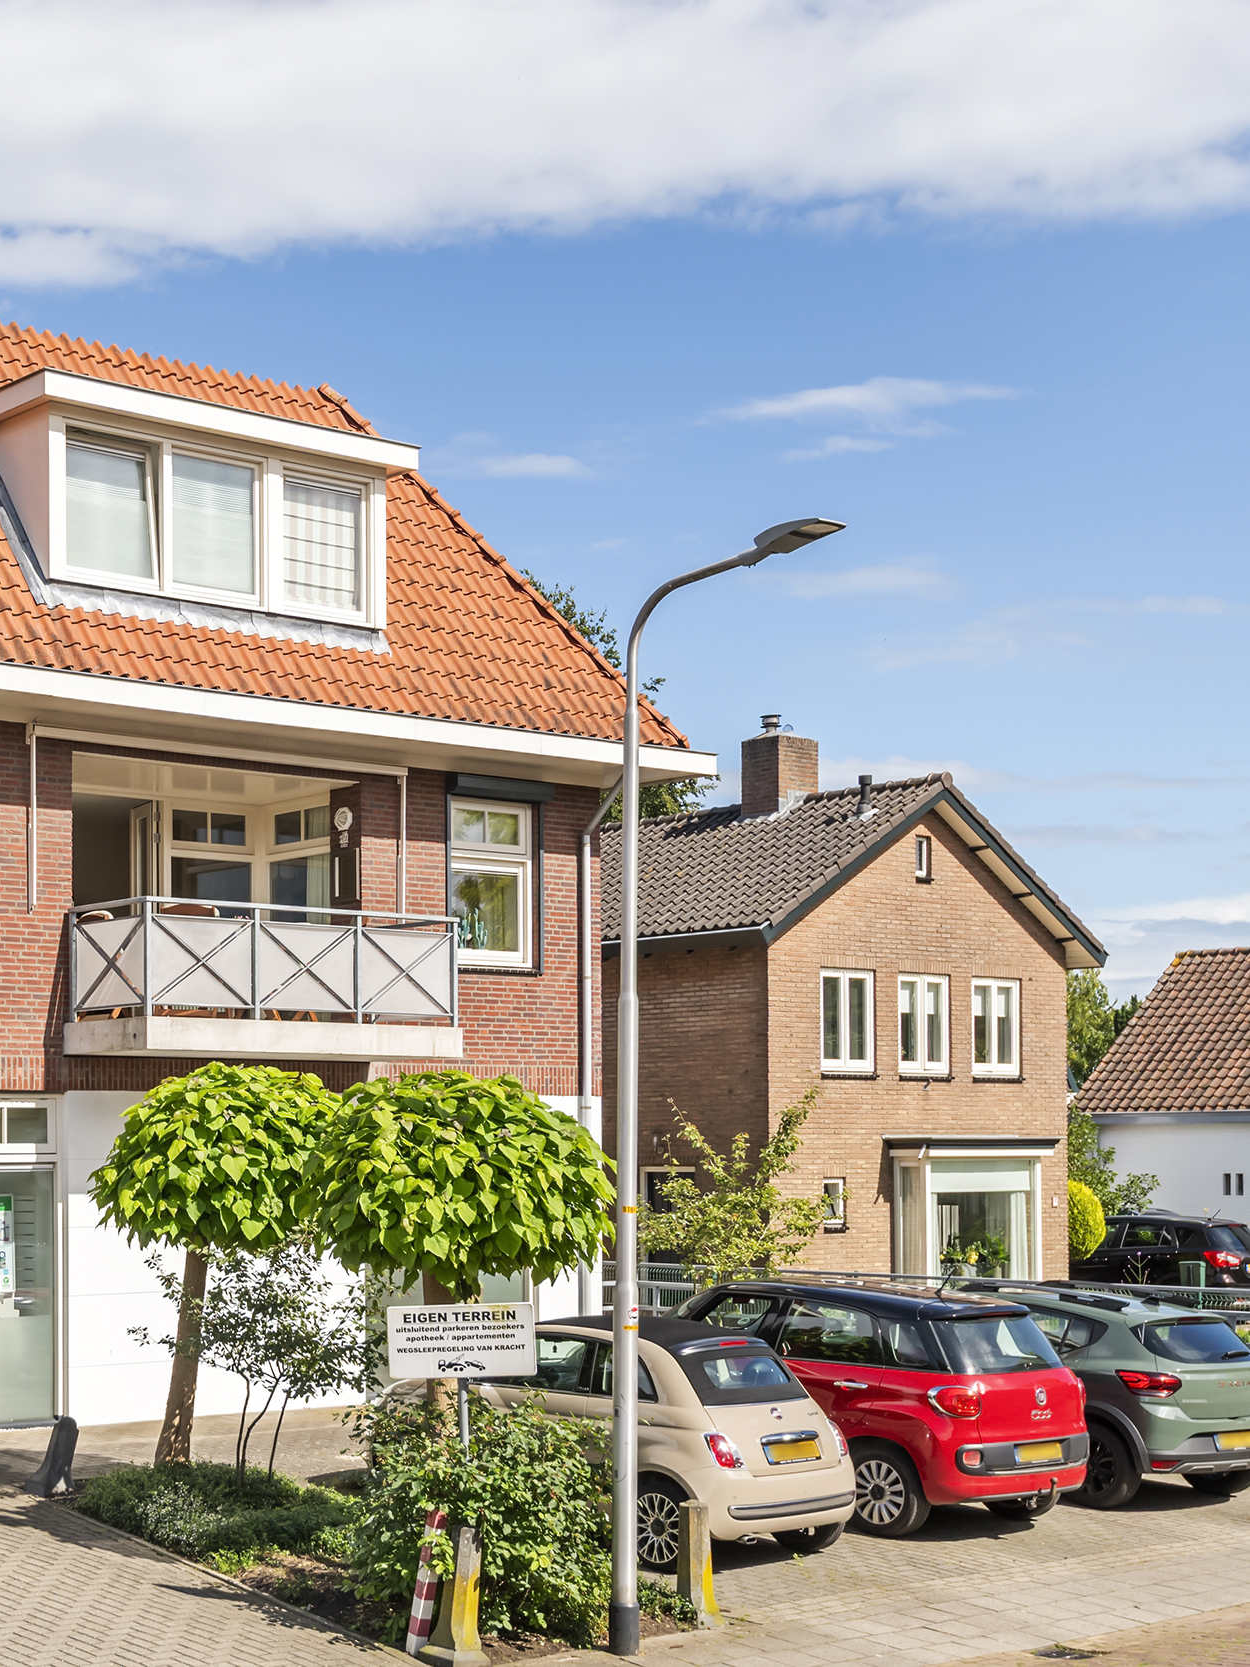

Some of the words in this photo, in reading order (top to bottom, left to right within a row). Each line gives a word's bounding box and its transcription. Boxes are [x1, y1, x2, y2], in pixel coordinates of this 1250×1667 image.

[403, 1312, 448, 1323] EIGEN
[452, 1310, 517, 1322] TERREIN
[396, 1325, 440, 1333] uitsluitend
[442, 1325, 480, 1333] parkeren
[482, 1323, 525, 1331] bezoekers
[405, 1334, 445, 1343] apotheek
[451, 1333, 516, 1341] appartementen
